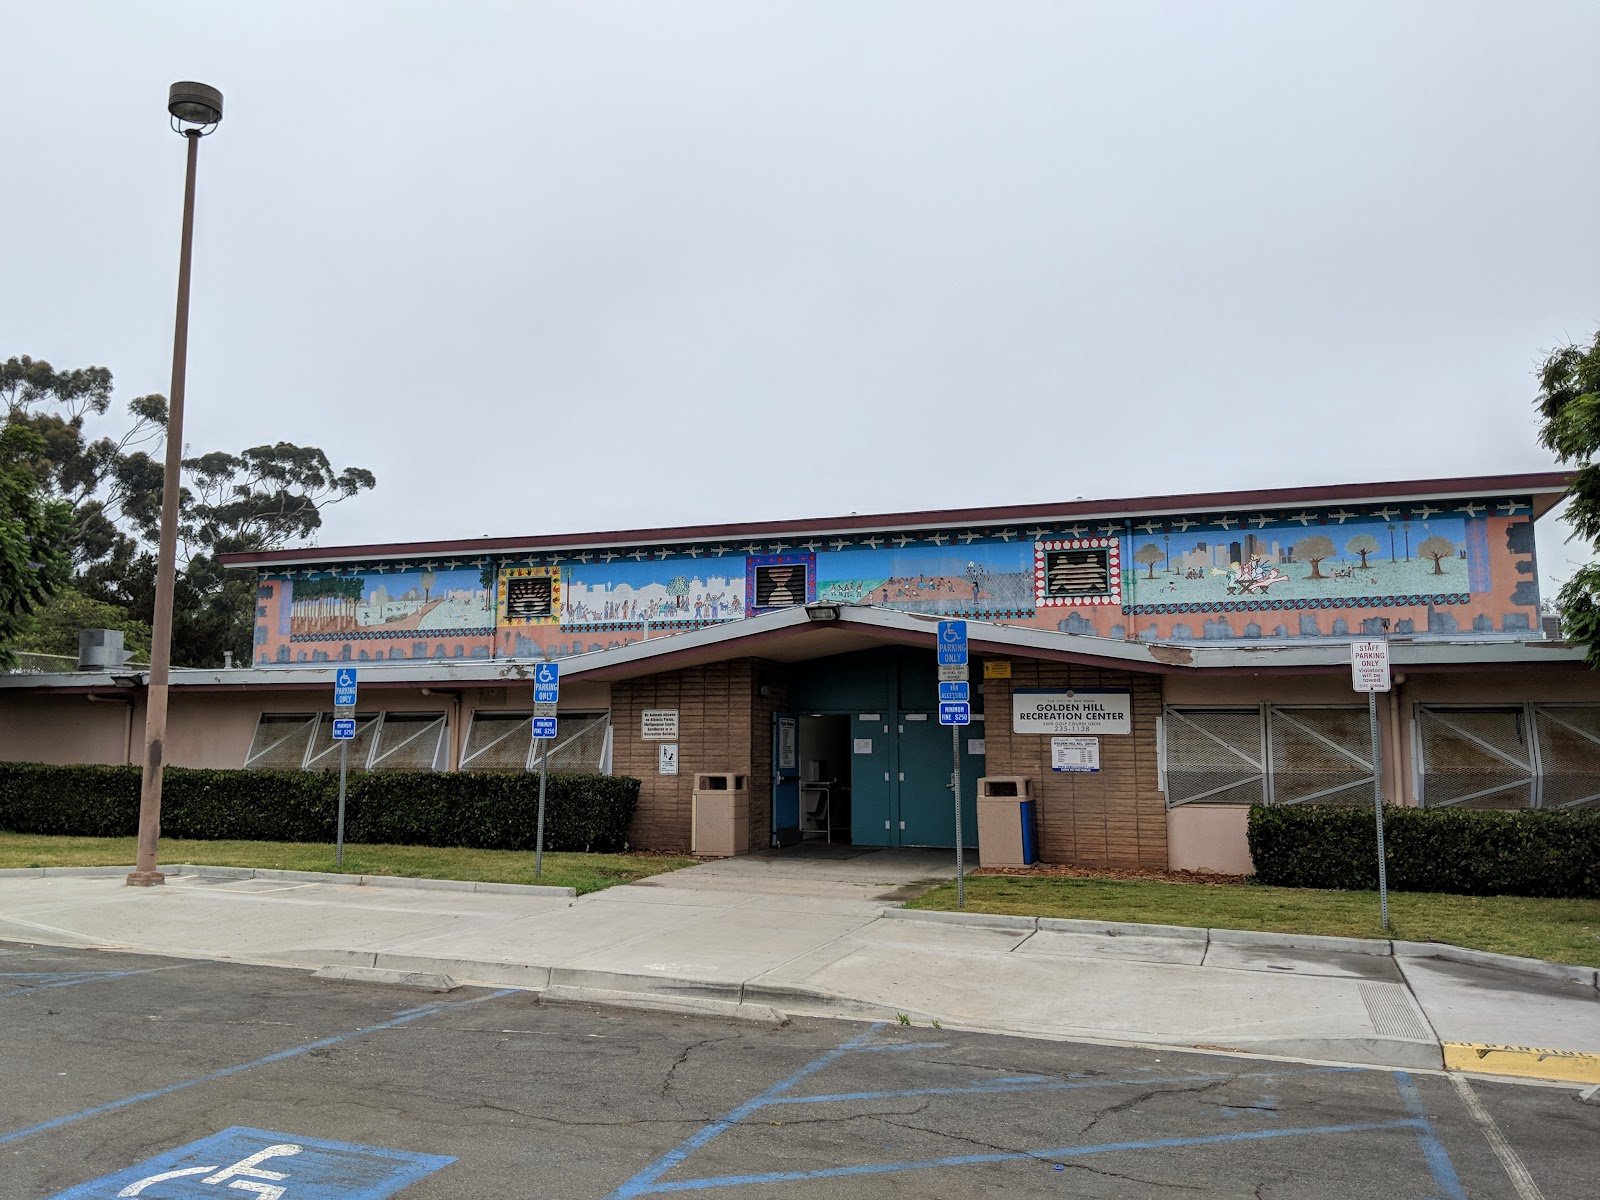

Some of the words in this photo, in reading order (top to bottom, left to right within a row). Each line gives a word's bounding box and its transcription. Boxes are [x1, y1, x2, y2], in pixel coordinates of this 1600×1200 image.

[940, 644, 966, 652] PARKING
[336, 687, 356, 695] PARKING
[536, 683, 558, 691] PARKING
[339, 695, 352, 703] ONLY
[538, 692, 554, 700] ONLY
[1020, 712, 1082, 720] RECREATION
[1086, 712, 1124, 720] CENTER
[1484, 1044, 1594, 1058] PARKING
